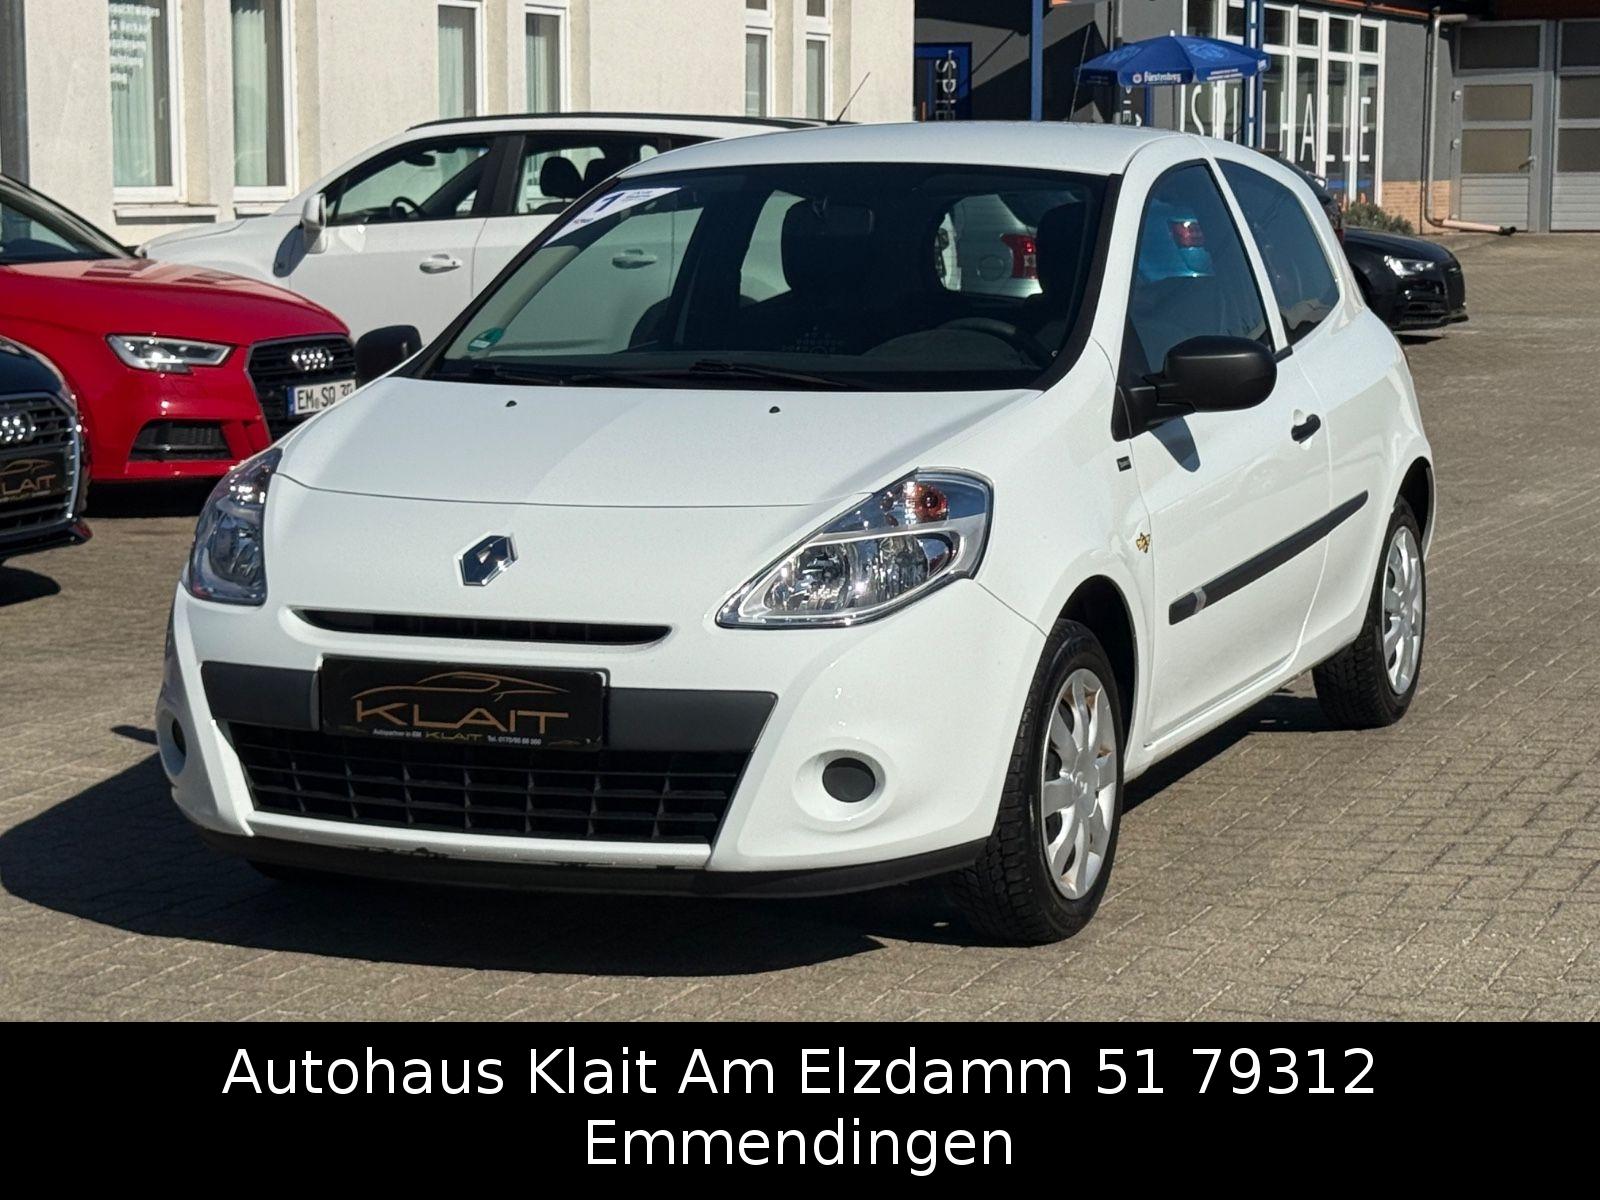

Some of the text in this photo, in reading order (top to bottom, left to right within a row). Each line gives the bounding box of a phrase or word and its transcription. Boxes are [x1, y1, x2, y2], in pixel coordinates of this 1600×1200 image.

[297, 389, 314, 410] EM
[355, 699, 569, 734] KLAIT
[426, 731, 483, 741] KLAIT
